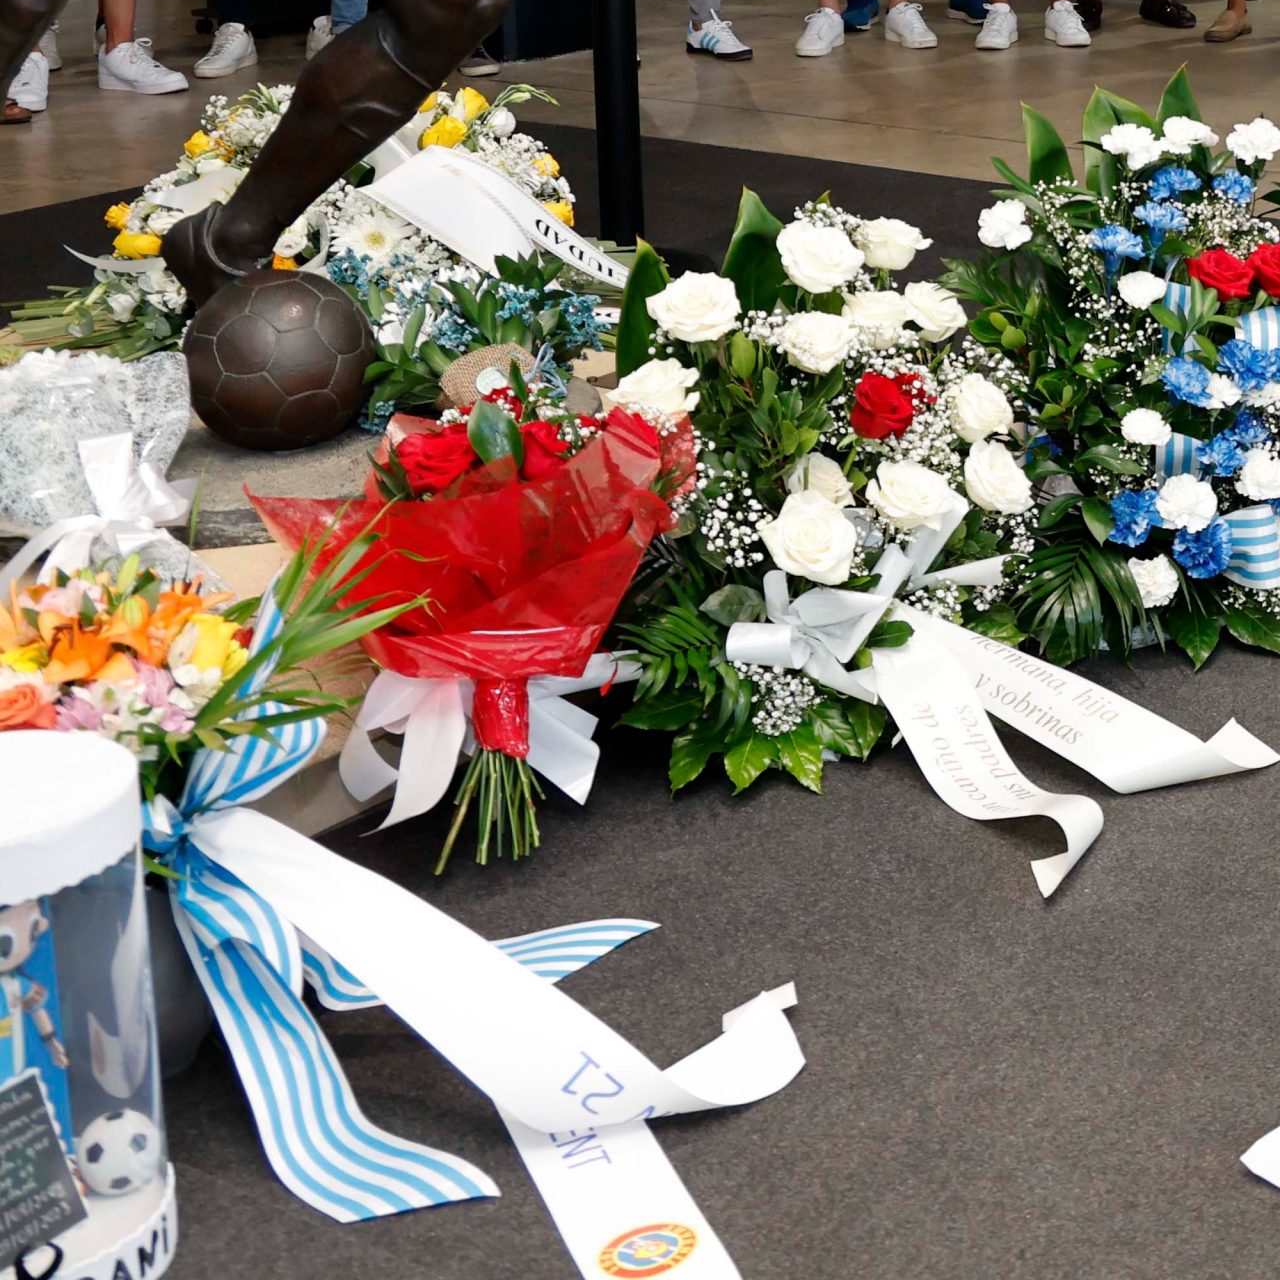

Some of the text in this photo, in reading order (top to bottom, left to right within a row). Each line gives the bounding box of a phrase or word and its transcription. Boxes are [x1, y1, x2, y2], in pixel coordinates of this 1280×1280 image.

[910, 701, 940, 729] de
[989, 681, 1084, 745] sobrinas
[1071, 687, 1119, 725] hija
[932, 736, 987, 802] cariño
[955, 703, 1010, 779] padres
[560, 1050, 625, 1116] 21
